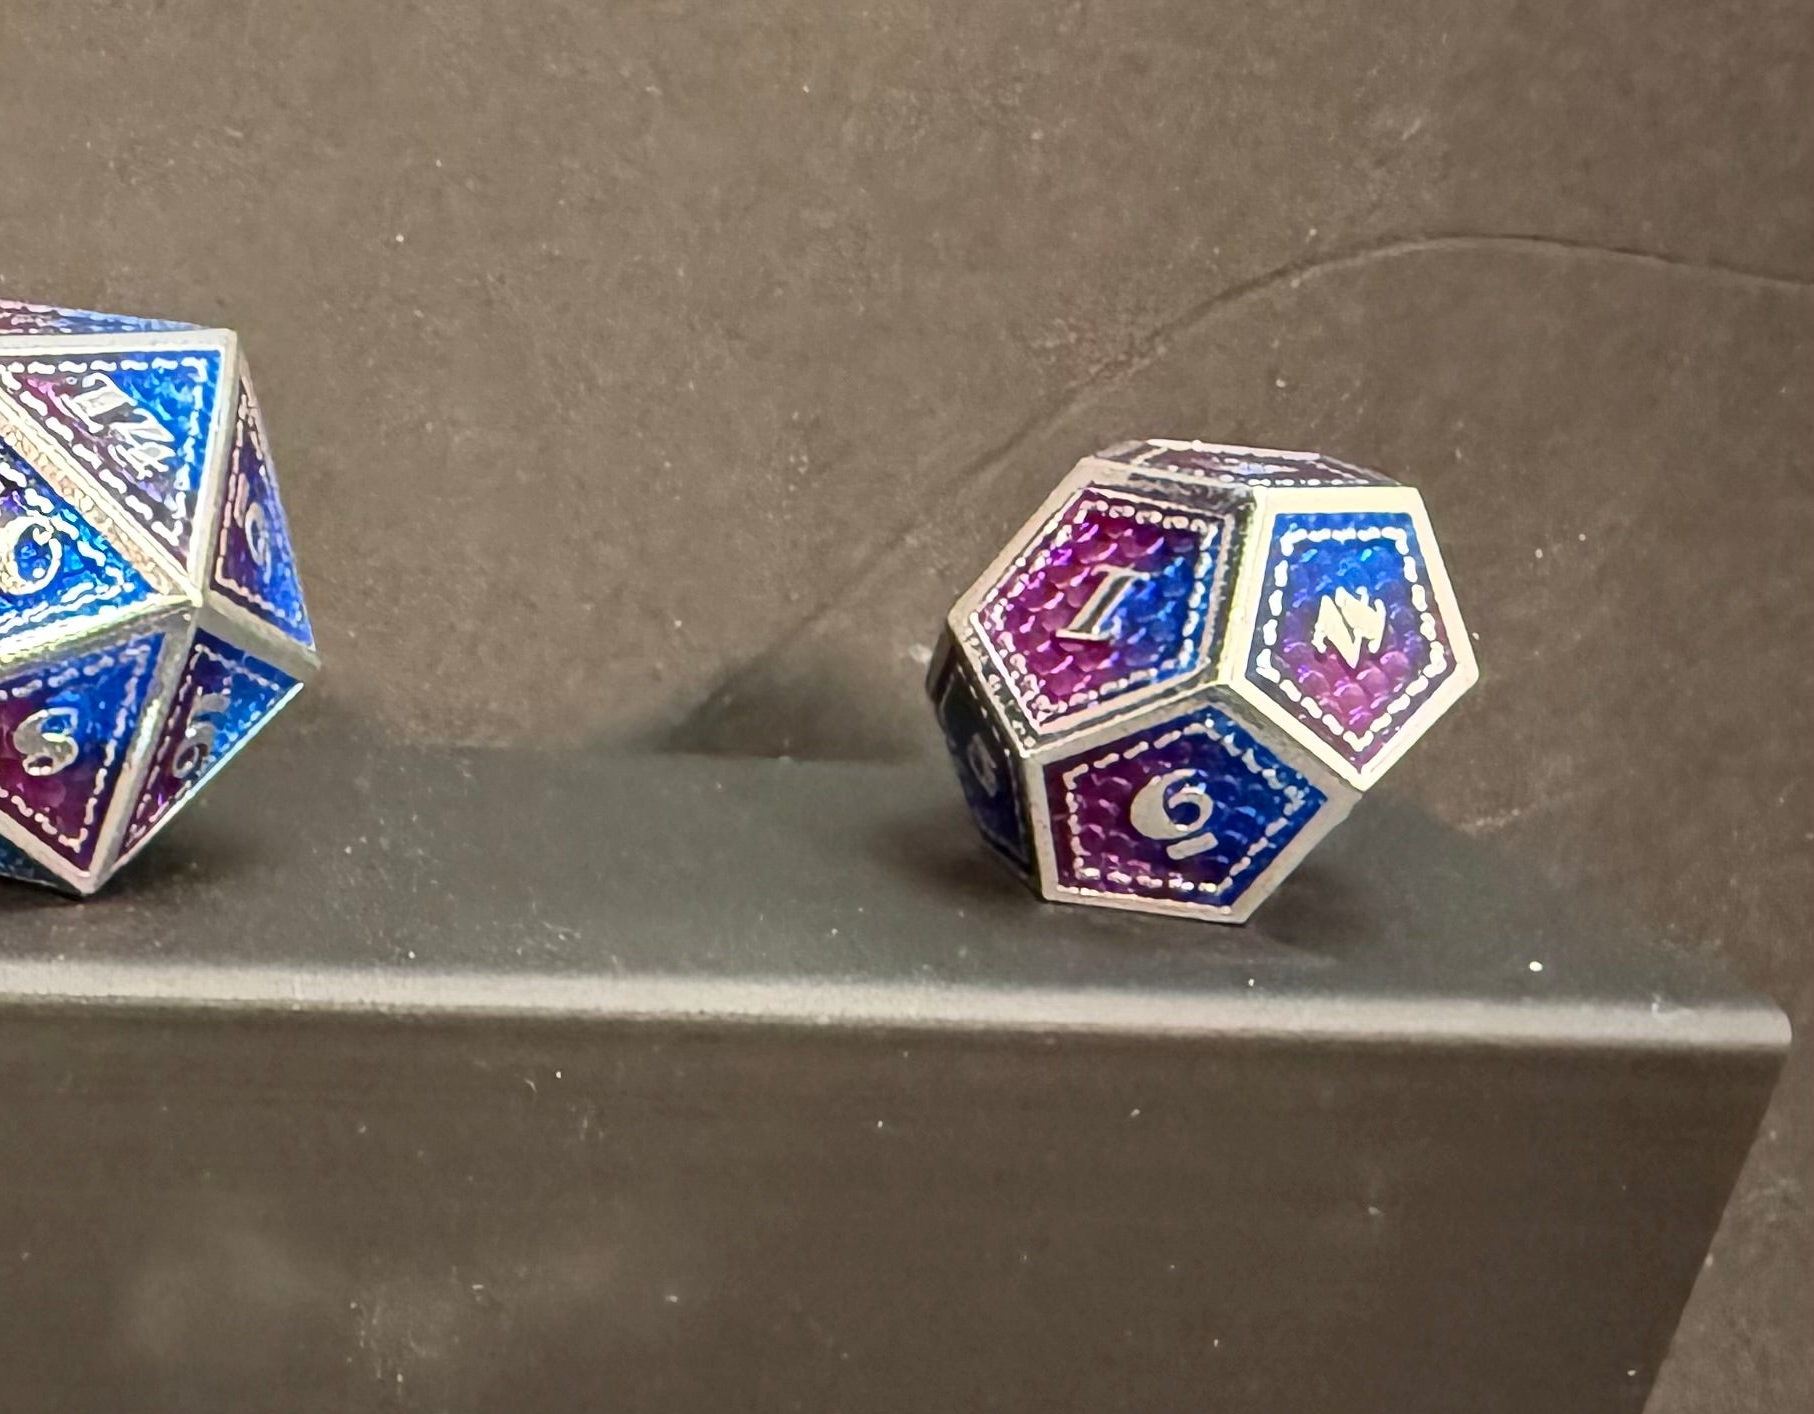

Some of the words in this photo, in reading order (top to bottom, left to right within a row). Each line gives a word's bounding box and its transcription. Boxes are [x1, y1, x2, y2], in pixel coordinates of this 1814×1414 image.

[1056, 565, 1151, 643] 1
[1311, 586, 1387, 669] 4
[1130, 767, 1219, 861] 6
